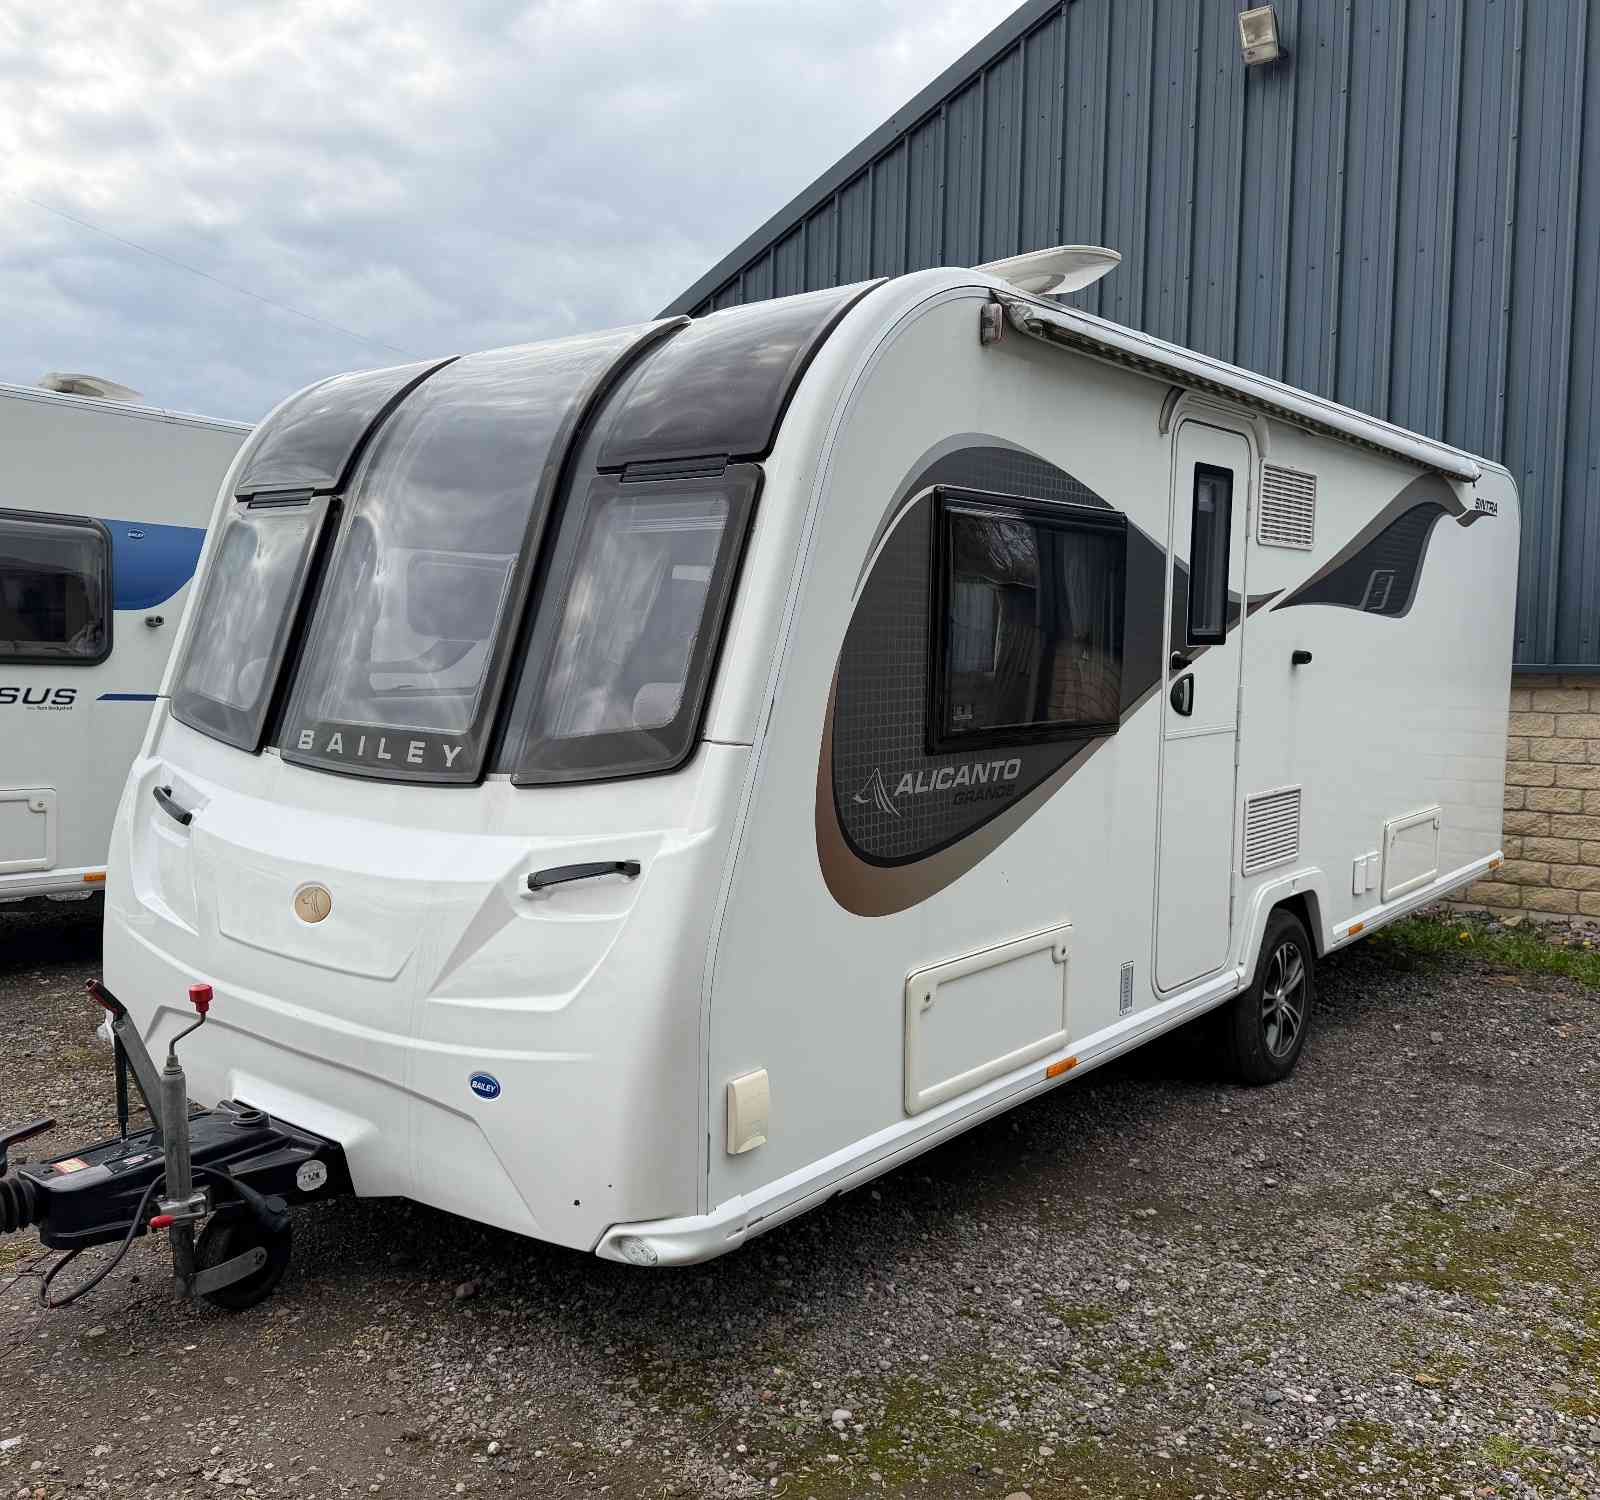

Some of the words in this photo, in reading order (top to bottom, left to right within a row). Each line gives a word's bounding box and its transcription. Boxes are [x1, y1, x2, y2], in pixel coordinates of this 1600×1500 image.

[297, 729, 463, 767] BAILEY
[893, 758, 1022, 797] ALICANTO
[953, 784, 1016, 805] GRANDE
[471, 1080, 496, 1093] BAILEY
